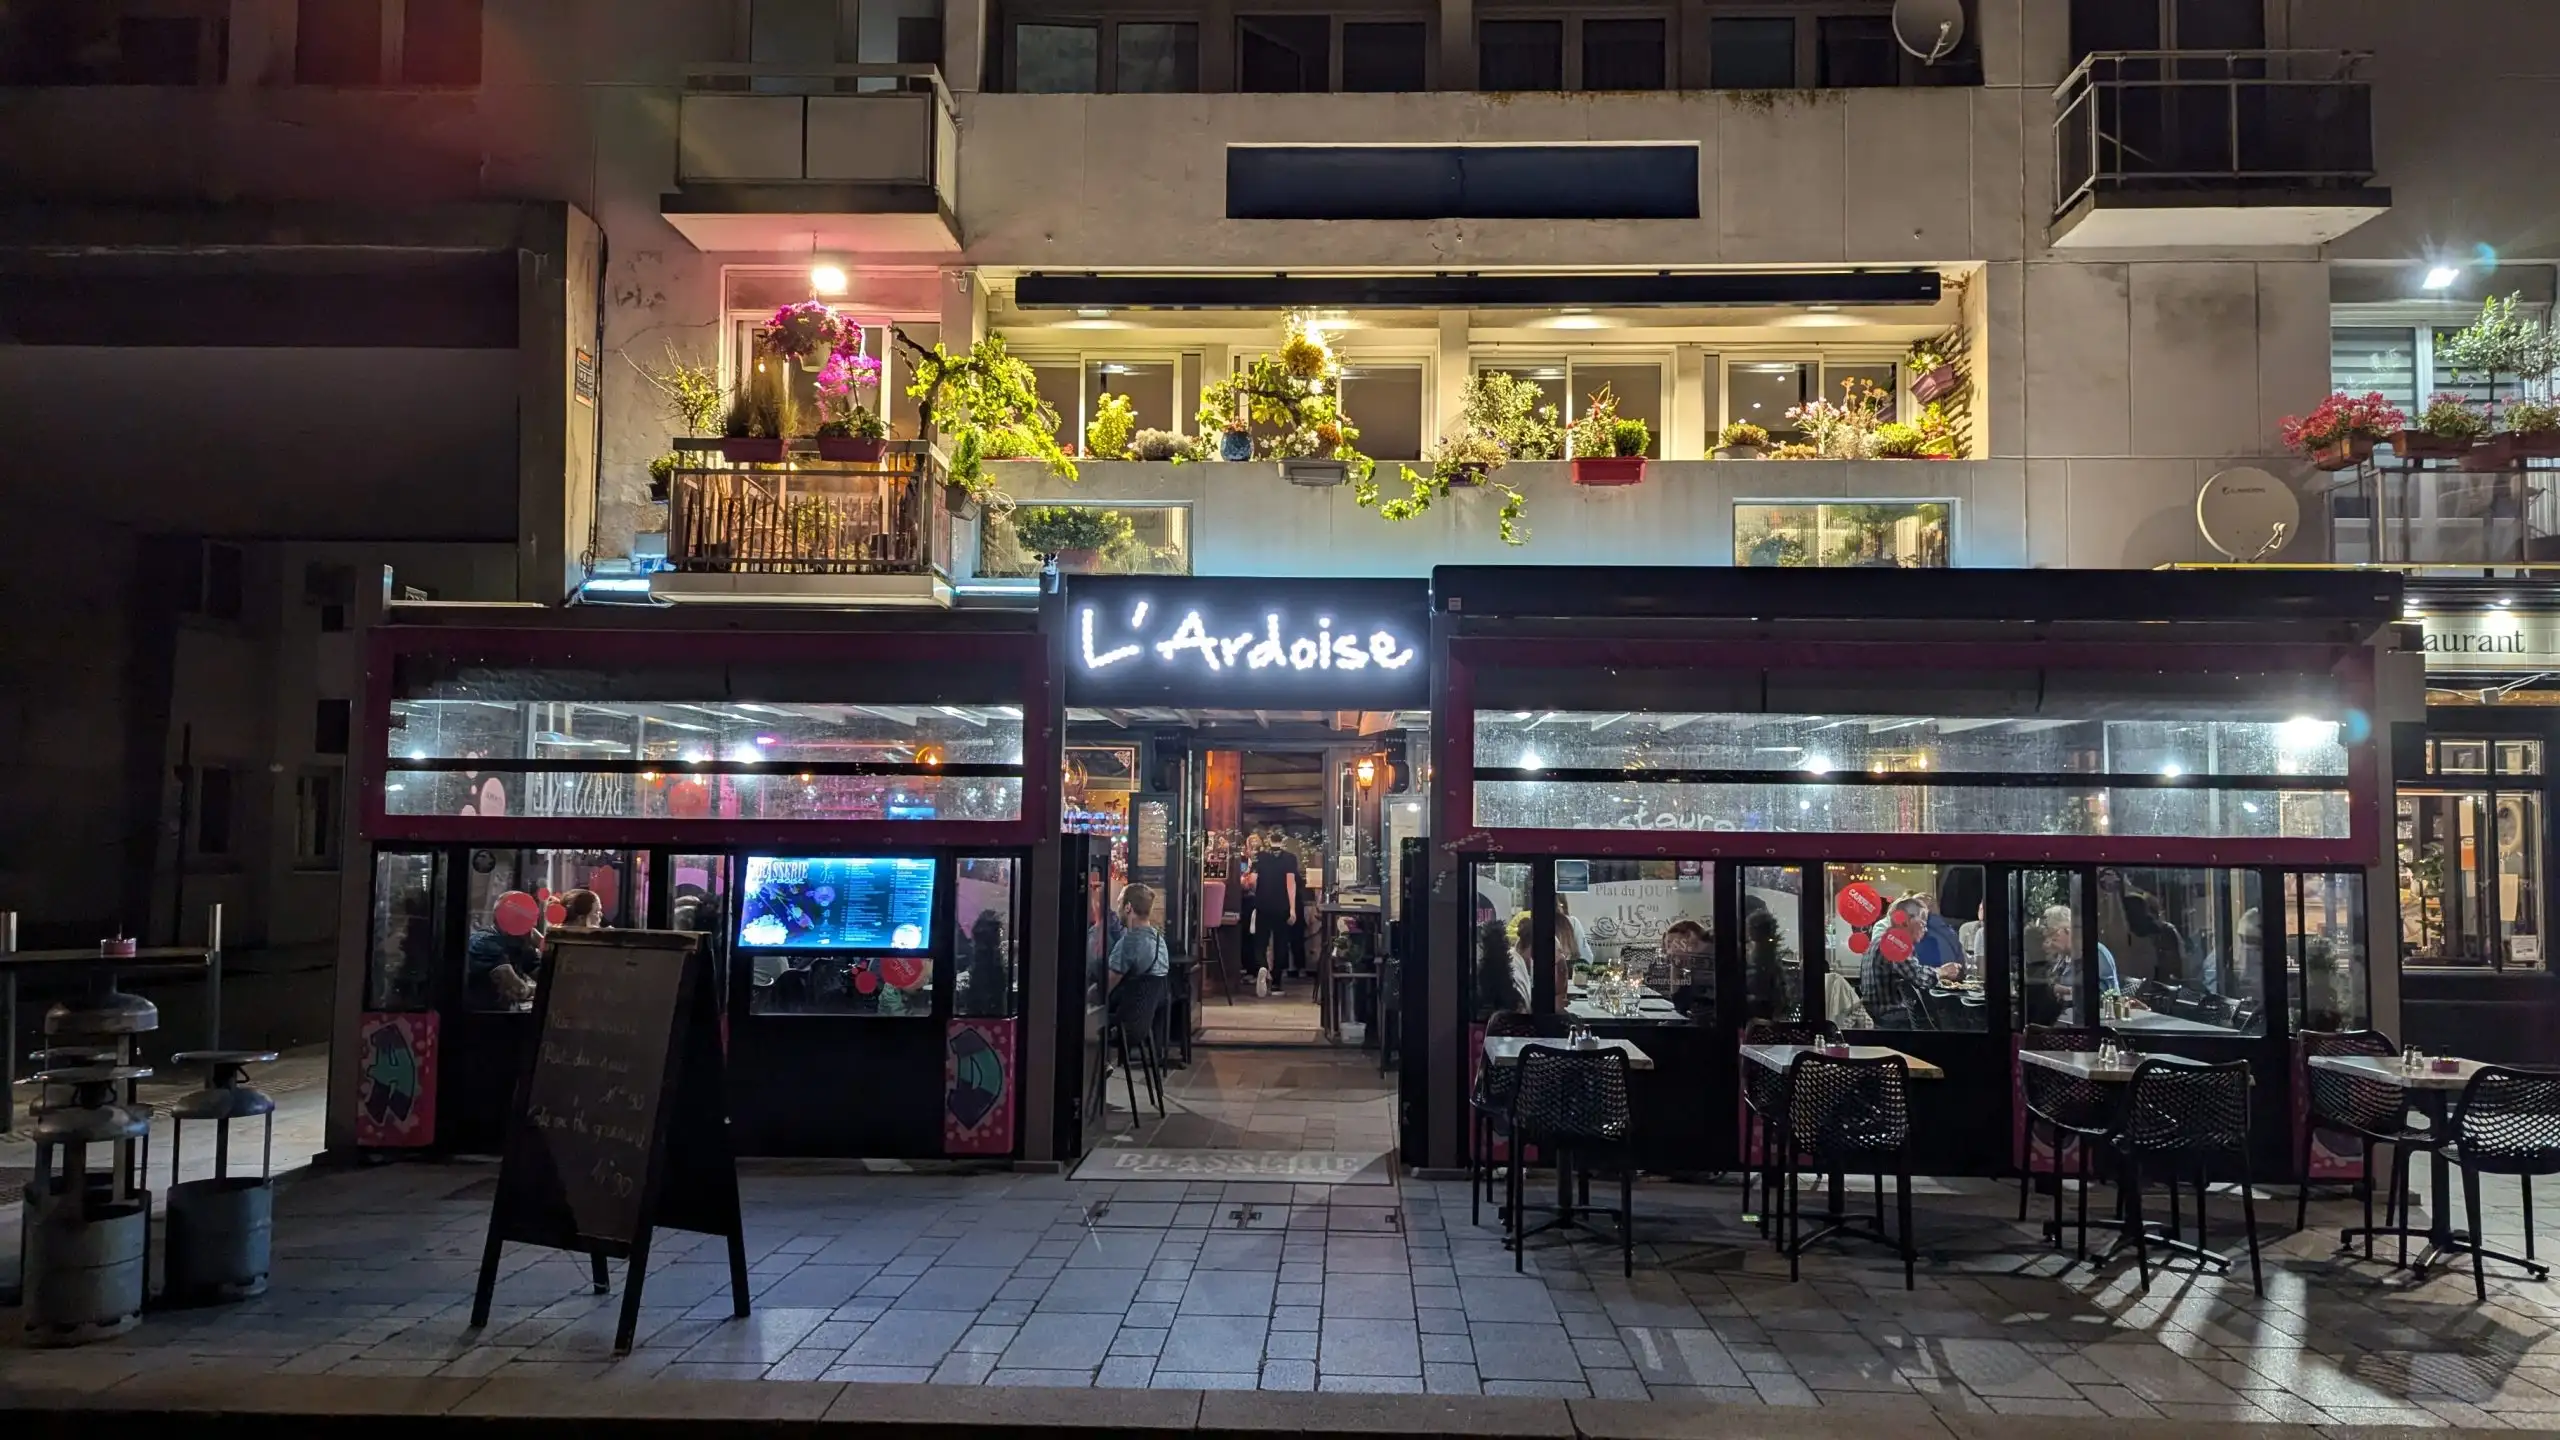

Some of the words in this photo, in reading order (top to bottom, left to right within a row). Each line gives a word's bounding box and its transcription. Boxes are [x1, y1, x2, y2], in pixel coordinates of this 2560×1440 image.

[1081, 600, 1414, 672] L'Ardoise
[2424, 630, 2526, 653] aurant
[1595, 884, 1617, 896] Plat
[1621, 884, 1635, 896] du
[1638, 884, 1674, 899] JOUR
